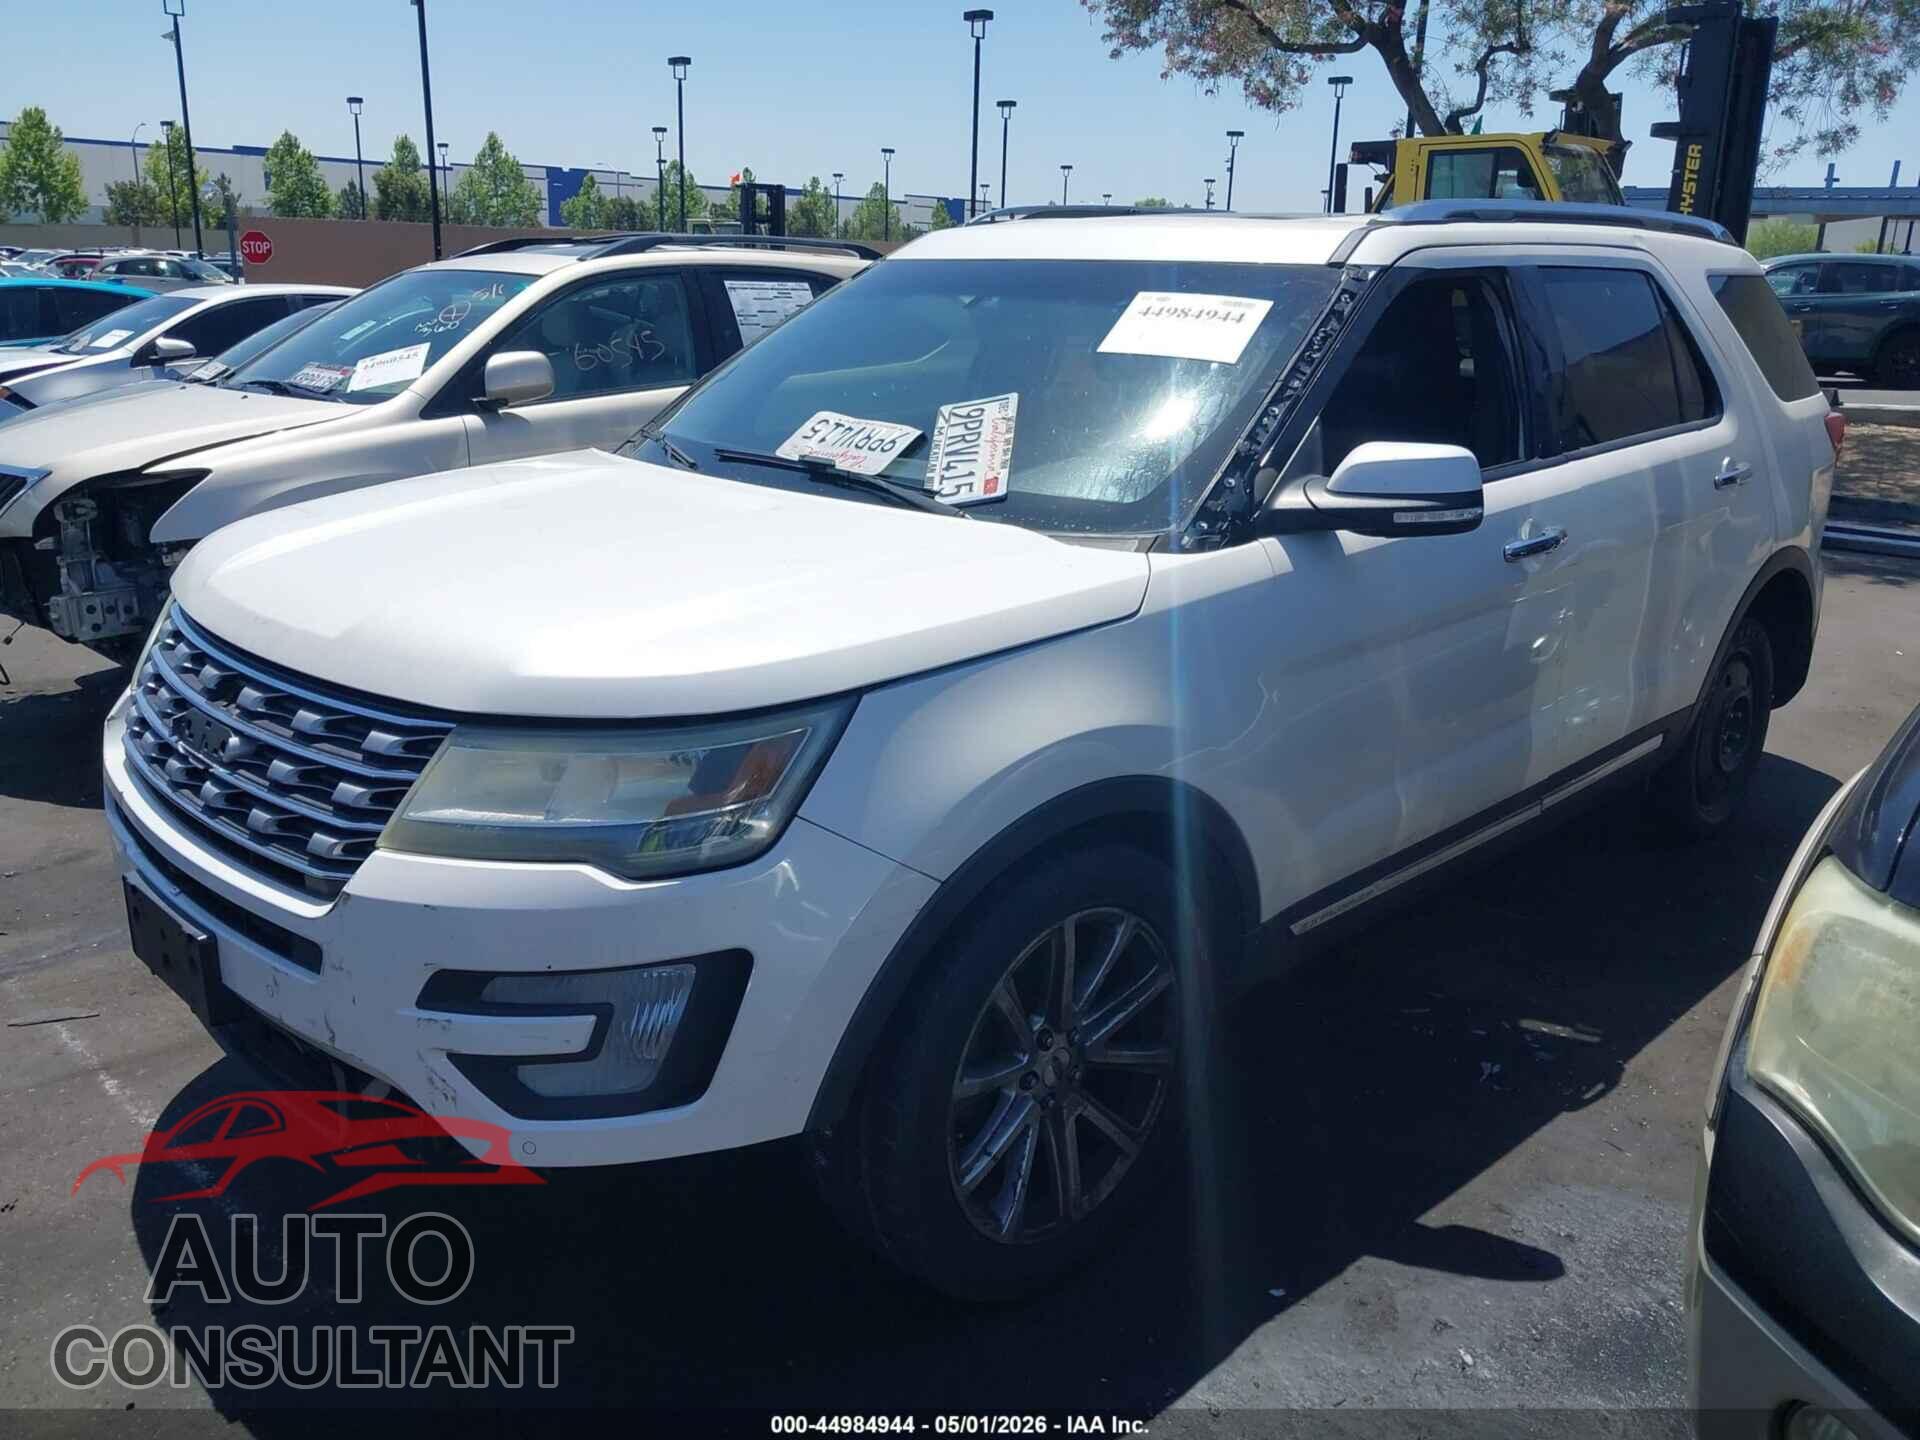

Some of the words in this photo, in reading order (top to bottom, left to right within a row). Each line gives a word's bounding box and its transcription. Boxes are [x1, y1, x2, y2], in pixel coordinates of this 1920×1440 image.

[1679, 143, 1703, 216] HYSTER
[242, 240, 270, 254] STOP
[1138, 305, 1246, 324] 44984944
[574, 329, 665, 371] 60545
[800, 418, 911, 454] 9PRV415
[940, 407, 986, 498] 9PRV415
